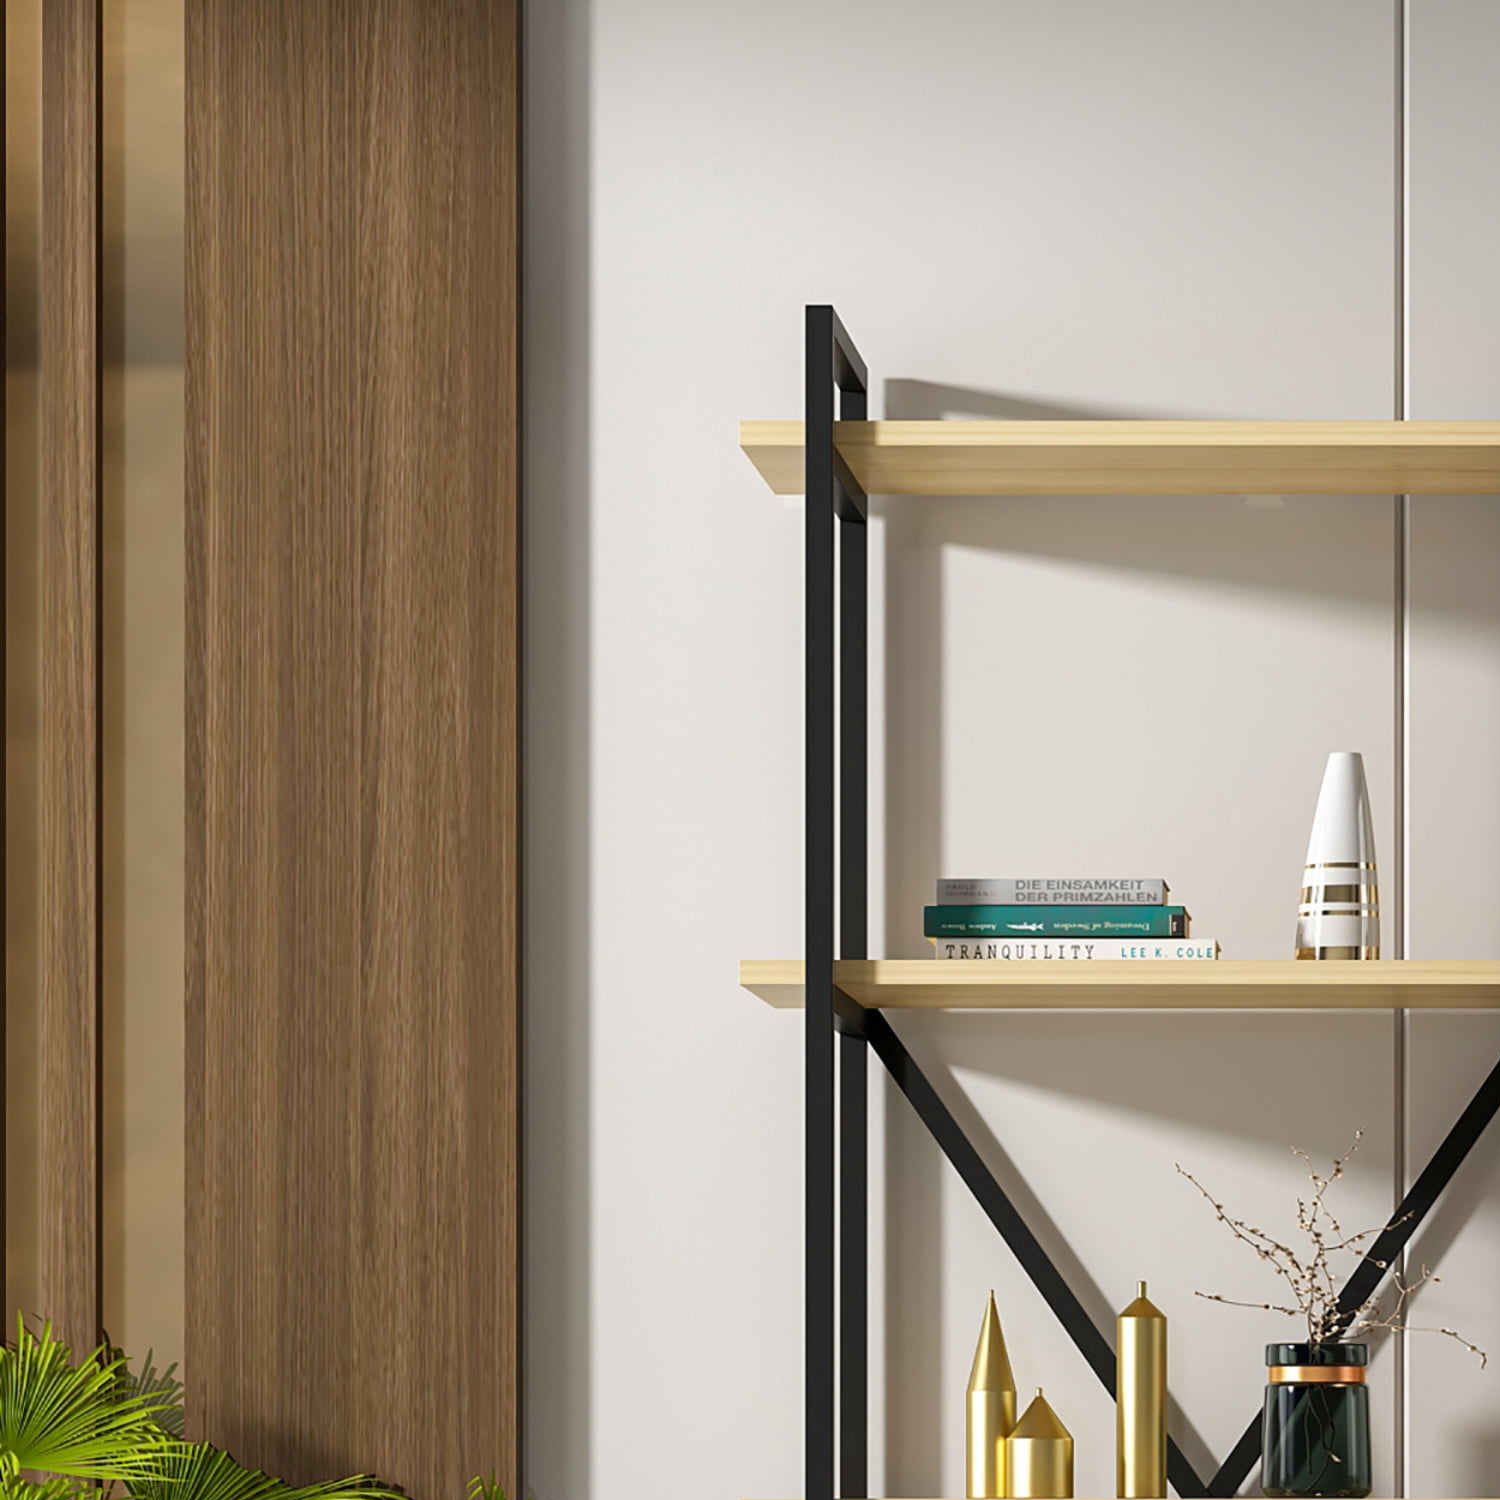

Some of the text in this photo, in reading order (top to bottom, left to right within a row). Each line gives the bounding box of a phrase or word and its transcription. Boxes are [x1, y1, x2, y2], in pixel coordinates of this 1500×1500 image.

[1015, 879, 1145, 890] DIE EINSAMKEIT
[1015, 892, 1158, 902] DER PRIMZAHLEN
[946, 944, 1095, 960] TRANQUILITY
[1121, 947, 1213, 958] LEE K. COLE
